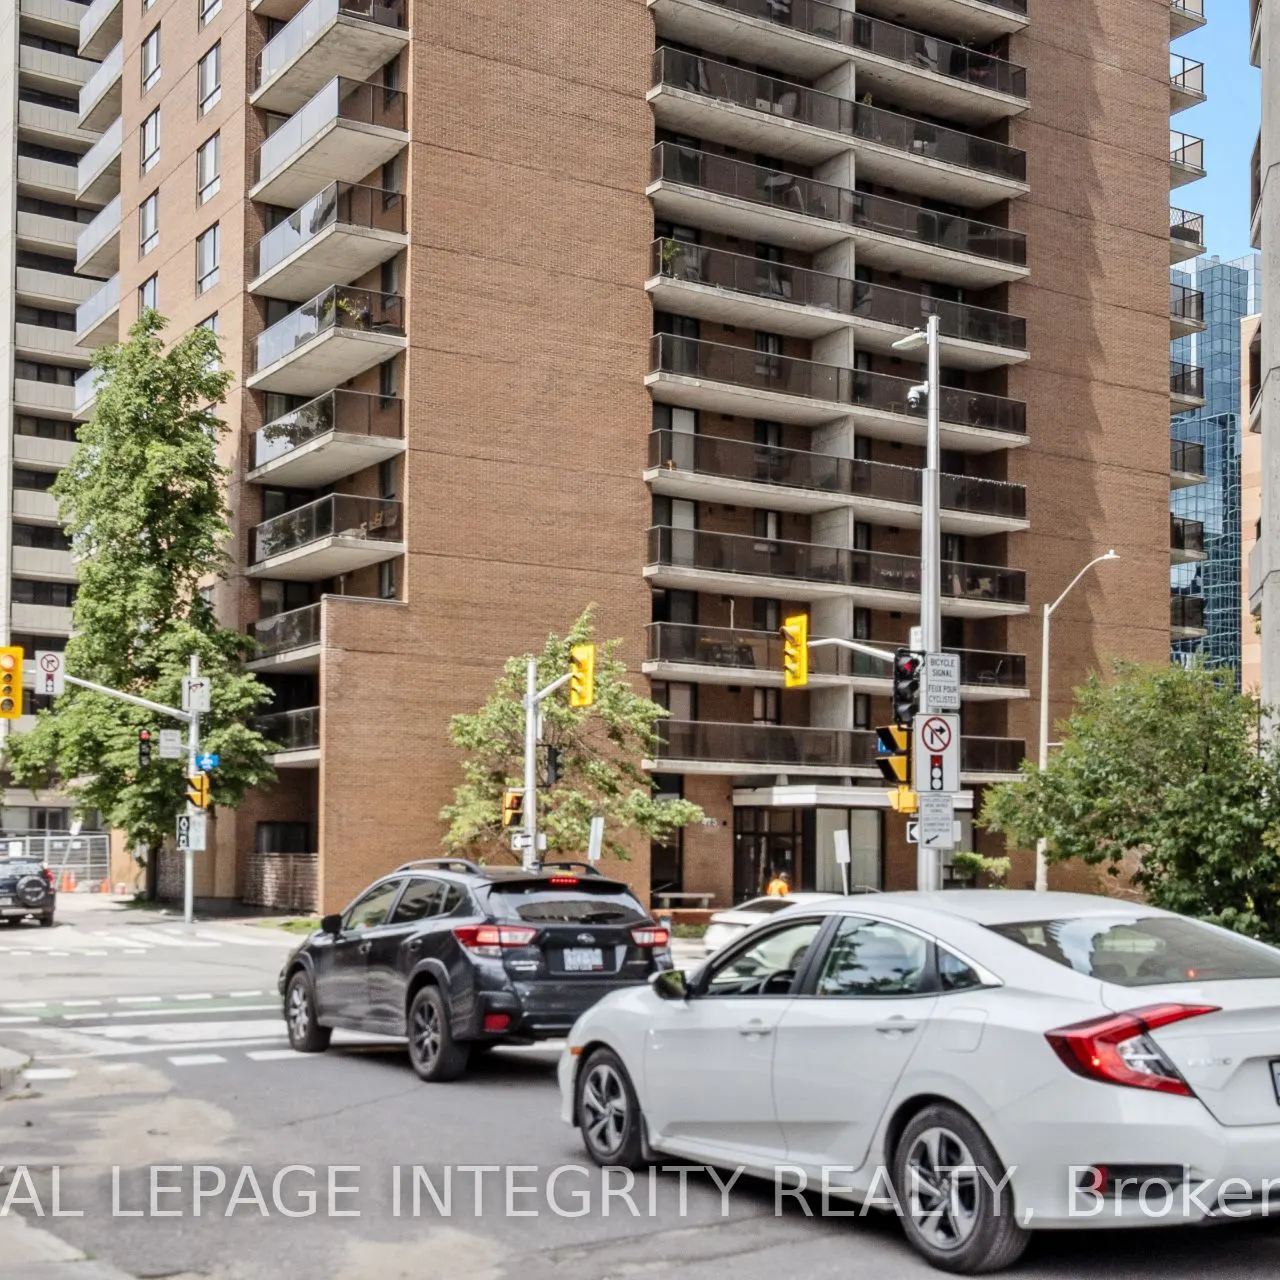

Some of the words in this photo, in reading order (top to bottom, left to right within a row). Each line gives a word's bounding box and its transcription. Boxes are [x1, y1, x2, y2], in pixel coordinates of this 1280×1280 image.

[930, 658, 955, 667] BICYCLE
[932, 669, 952, 677] SIGNAL
[943, 685, 957, 693] POUR
